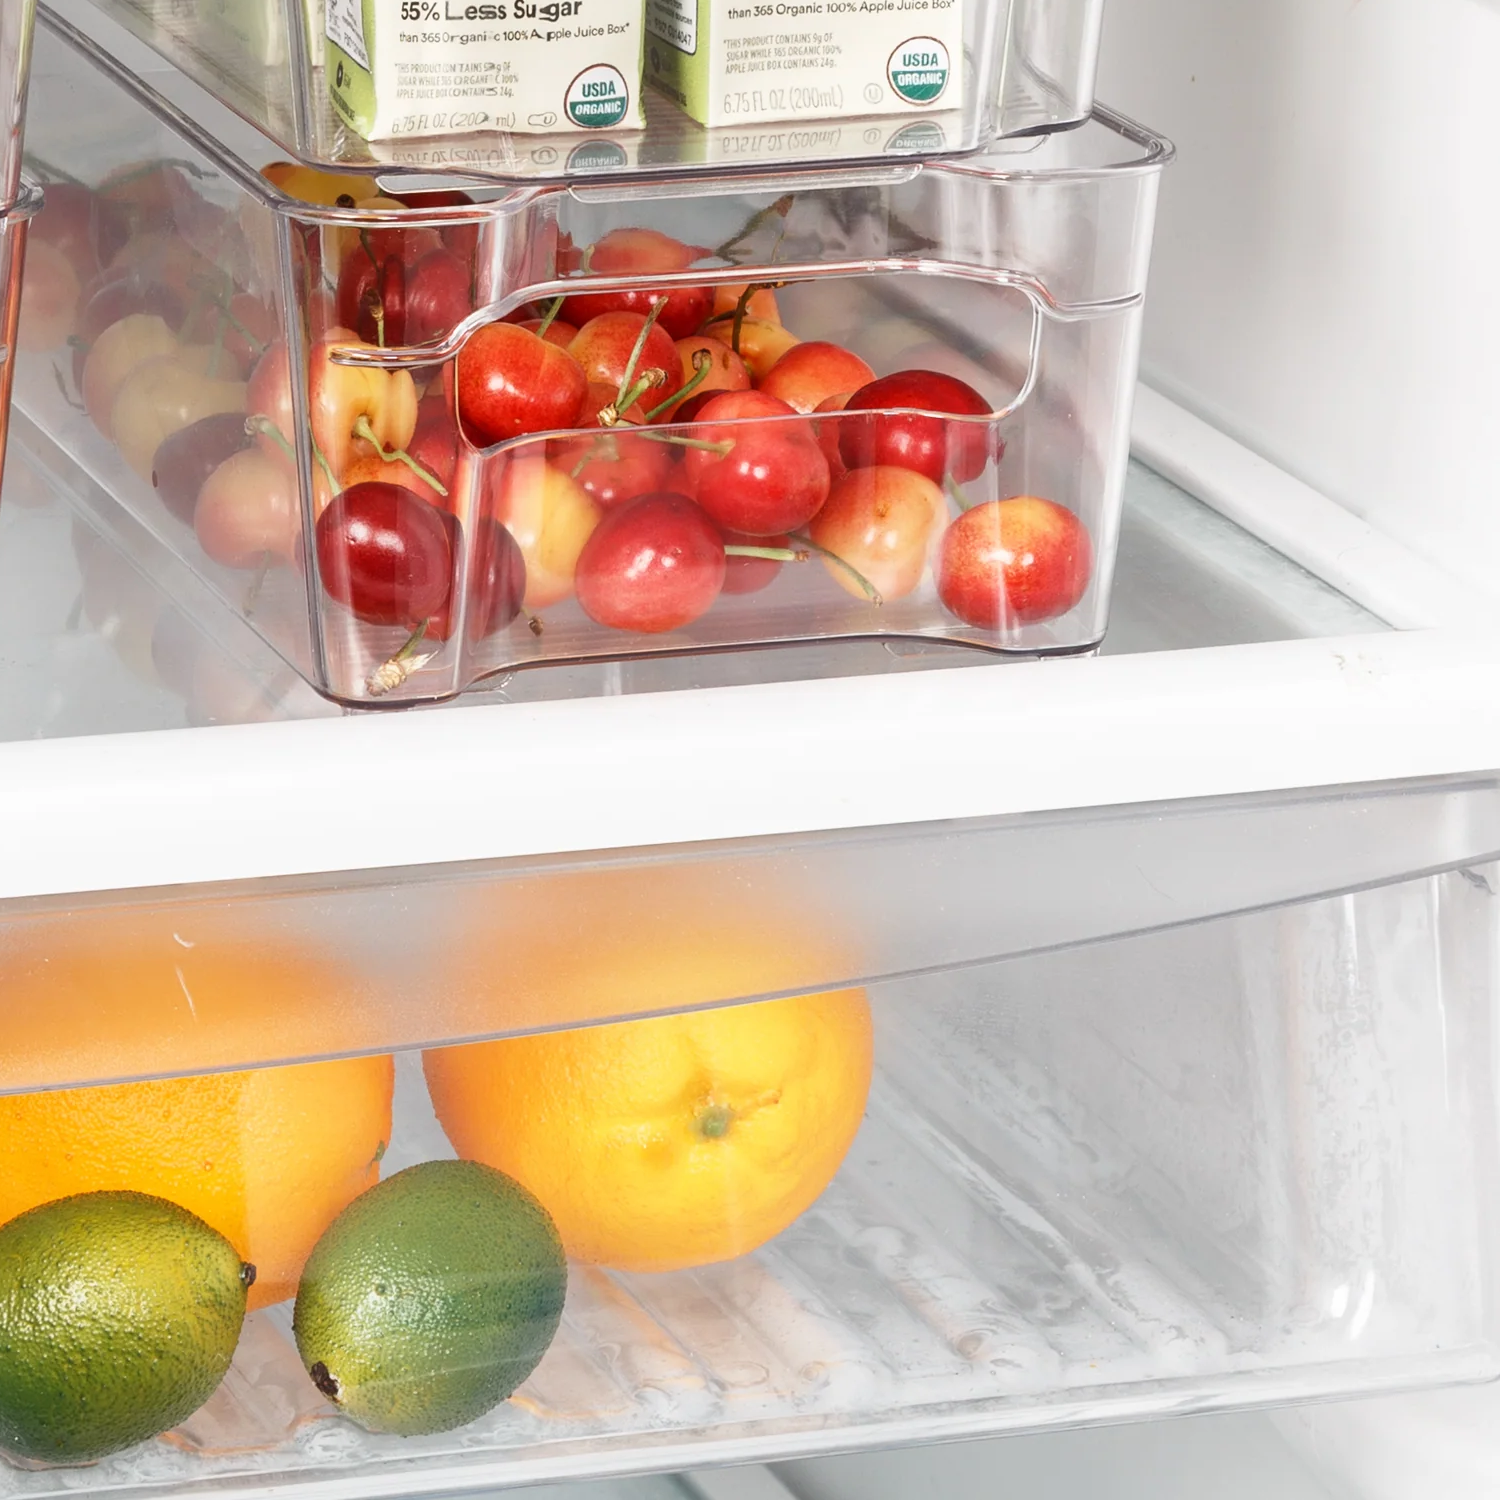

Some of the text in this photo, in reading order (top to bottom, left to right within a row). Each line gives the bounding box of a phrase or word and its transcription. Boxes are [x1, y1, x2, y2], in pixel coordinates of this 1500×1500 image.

[401, 0, 582, 22] 55% Less Sugar
[728, 8, 751, 19] than
[754, 5, 773, 17] 365
[776, 2, 822, 17] Organic
[827, 3, 857, 13] 100%
[860, 1, 894, 13] Apple
[897, 0, 929, 11] Juice
[399, 33, 418, 42] than
[421, 33, 440, 42] 365
[503, 30, 528, 41] 100%
[574, 25, 604, 38] Juice
[743, 36, 773, 47] PRODUCT
[775, 35, 811, 45] CONTAINS
[824, 33, 833, 42] OF
[726, 50, 748, 62] SUGAR
[750, 49, 772, 59] WHILE
[788, 47, 820, 57] ORGANIC
[902, 52, 938, 67] USDA
[725, 63, 746, 74] APPLE
[747, 62, 765, 72] JUICE
[767, 61, 781, 70] BOX
[783, 58, 819, 69] CONTAINS
[898, 72, 943, 86] ORGANIC
[582, 80, 616, 97] USDA
[723, 84, 844, 114] 6.75 FL OZ (200mL)
[575, 101, 621, 115] ORGANIC
[392, 115, 416, 134] 6.75
[417, 114, 427, 129] FL
[433, 113, 447, 127] OZ
